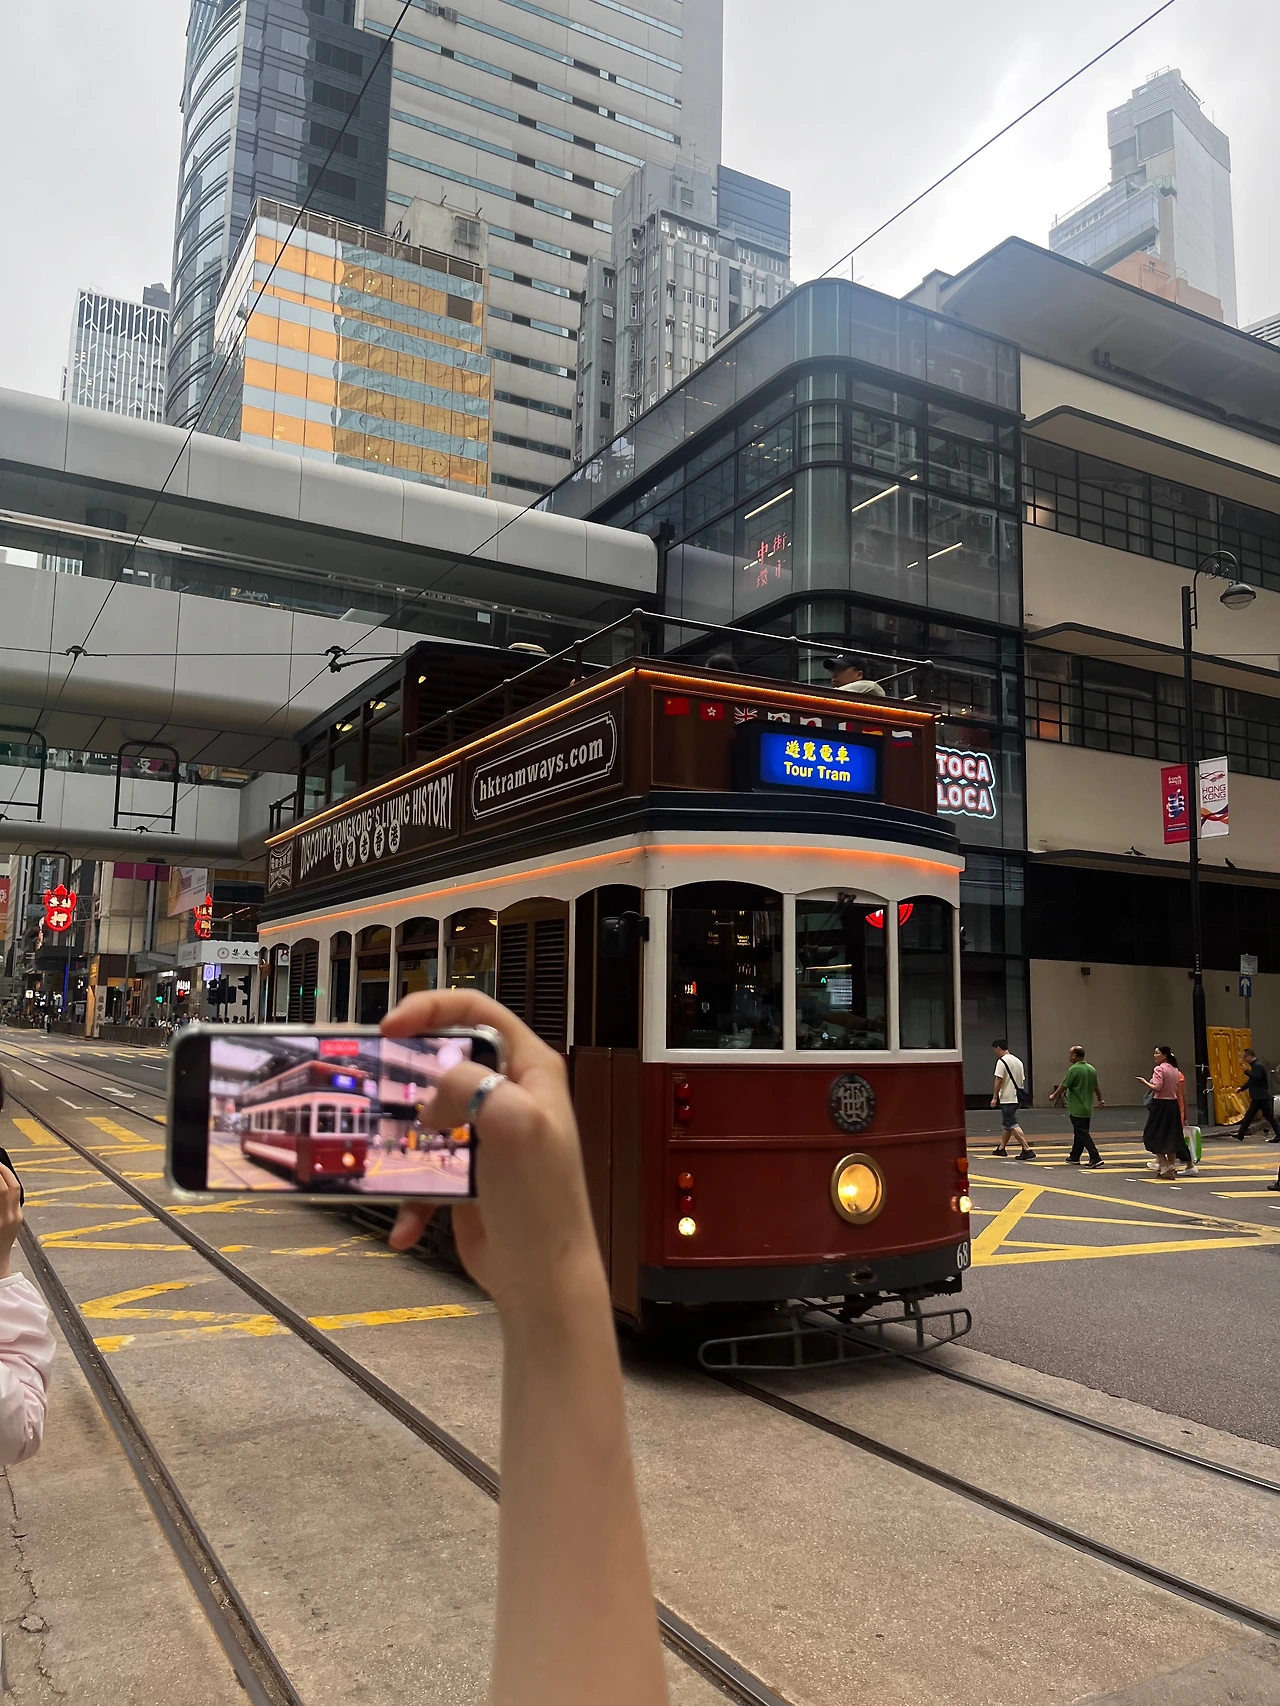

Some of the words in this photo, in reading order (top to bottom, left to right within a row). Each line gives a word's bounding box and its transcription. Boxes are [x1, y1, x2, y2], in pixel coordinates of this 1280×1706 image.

[784, 739, 851, 765] 遊覽電車
[479, 736, 604, 802] hktramways.com
[784, 761, 814, 778] Tour
[817, 764, 851, 783] Tram
[936, 753, 990, 783] TOCA
[937, 783, 991, 812] LOCA
[1202, 784, 1226, 794] HONG
[1203, 792, 1226, 801] KONG
[300, 826, 332, 880] DISCOVER
[381, 792, 410, 827] LIVING
[412, 772, 455, 830] HISTORY
[957, 1241, 968, 1269] 68
